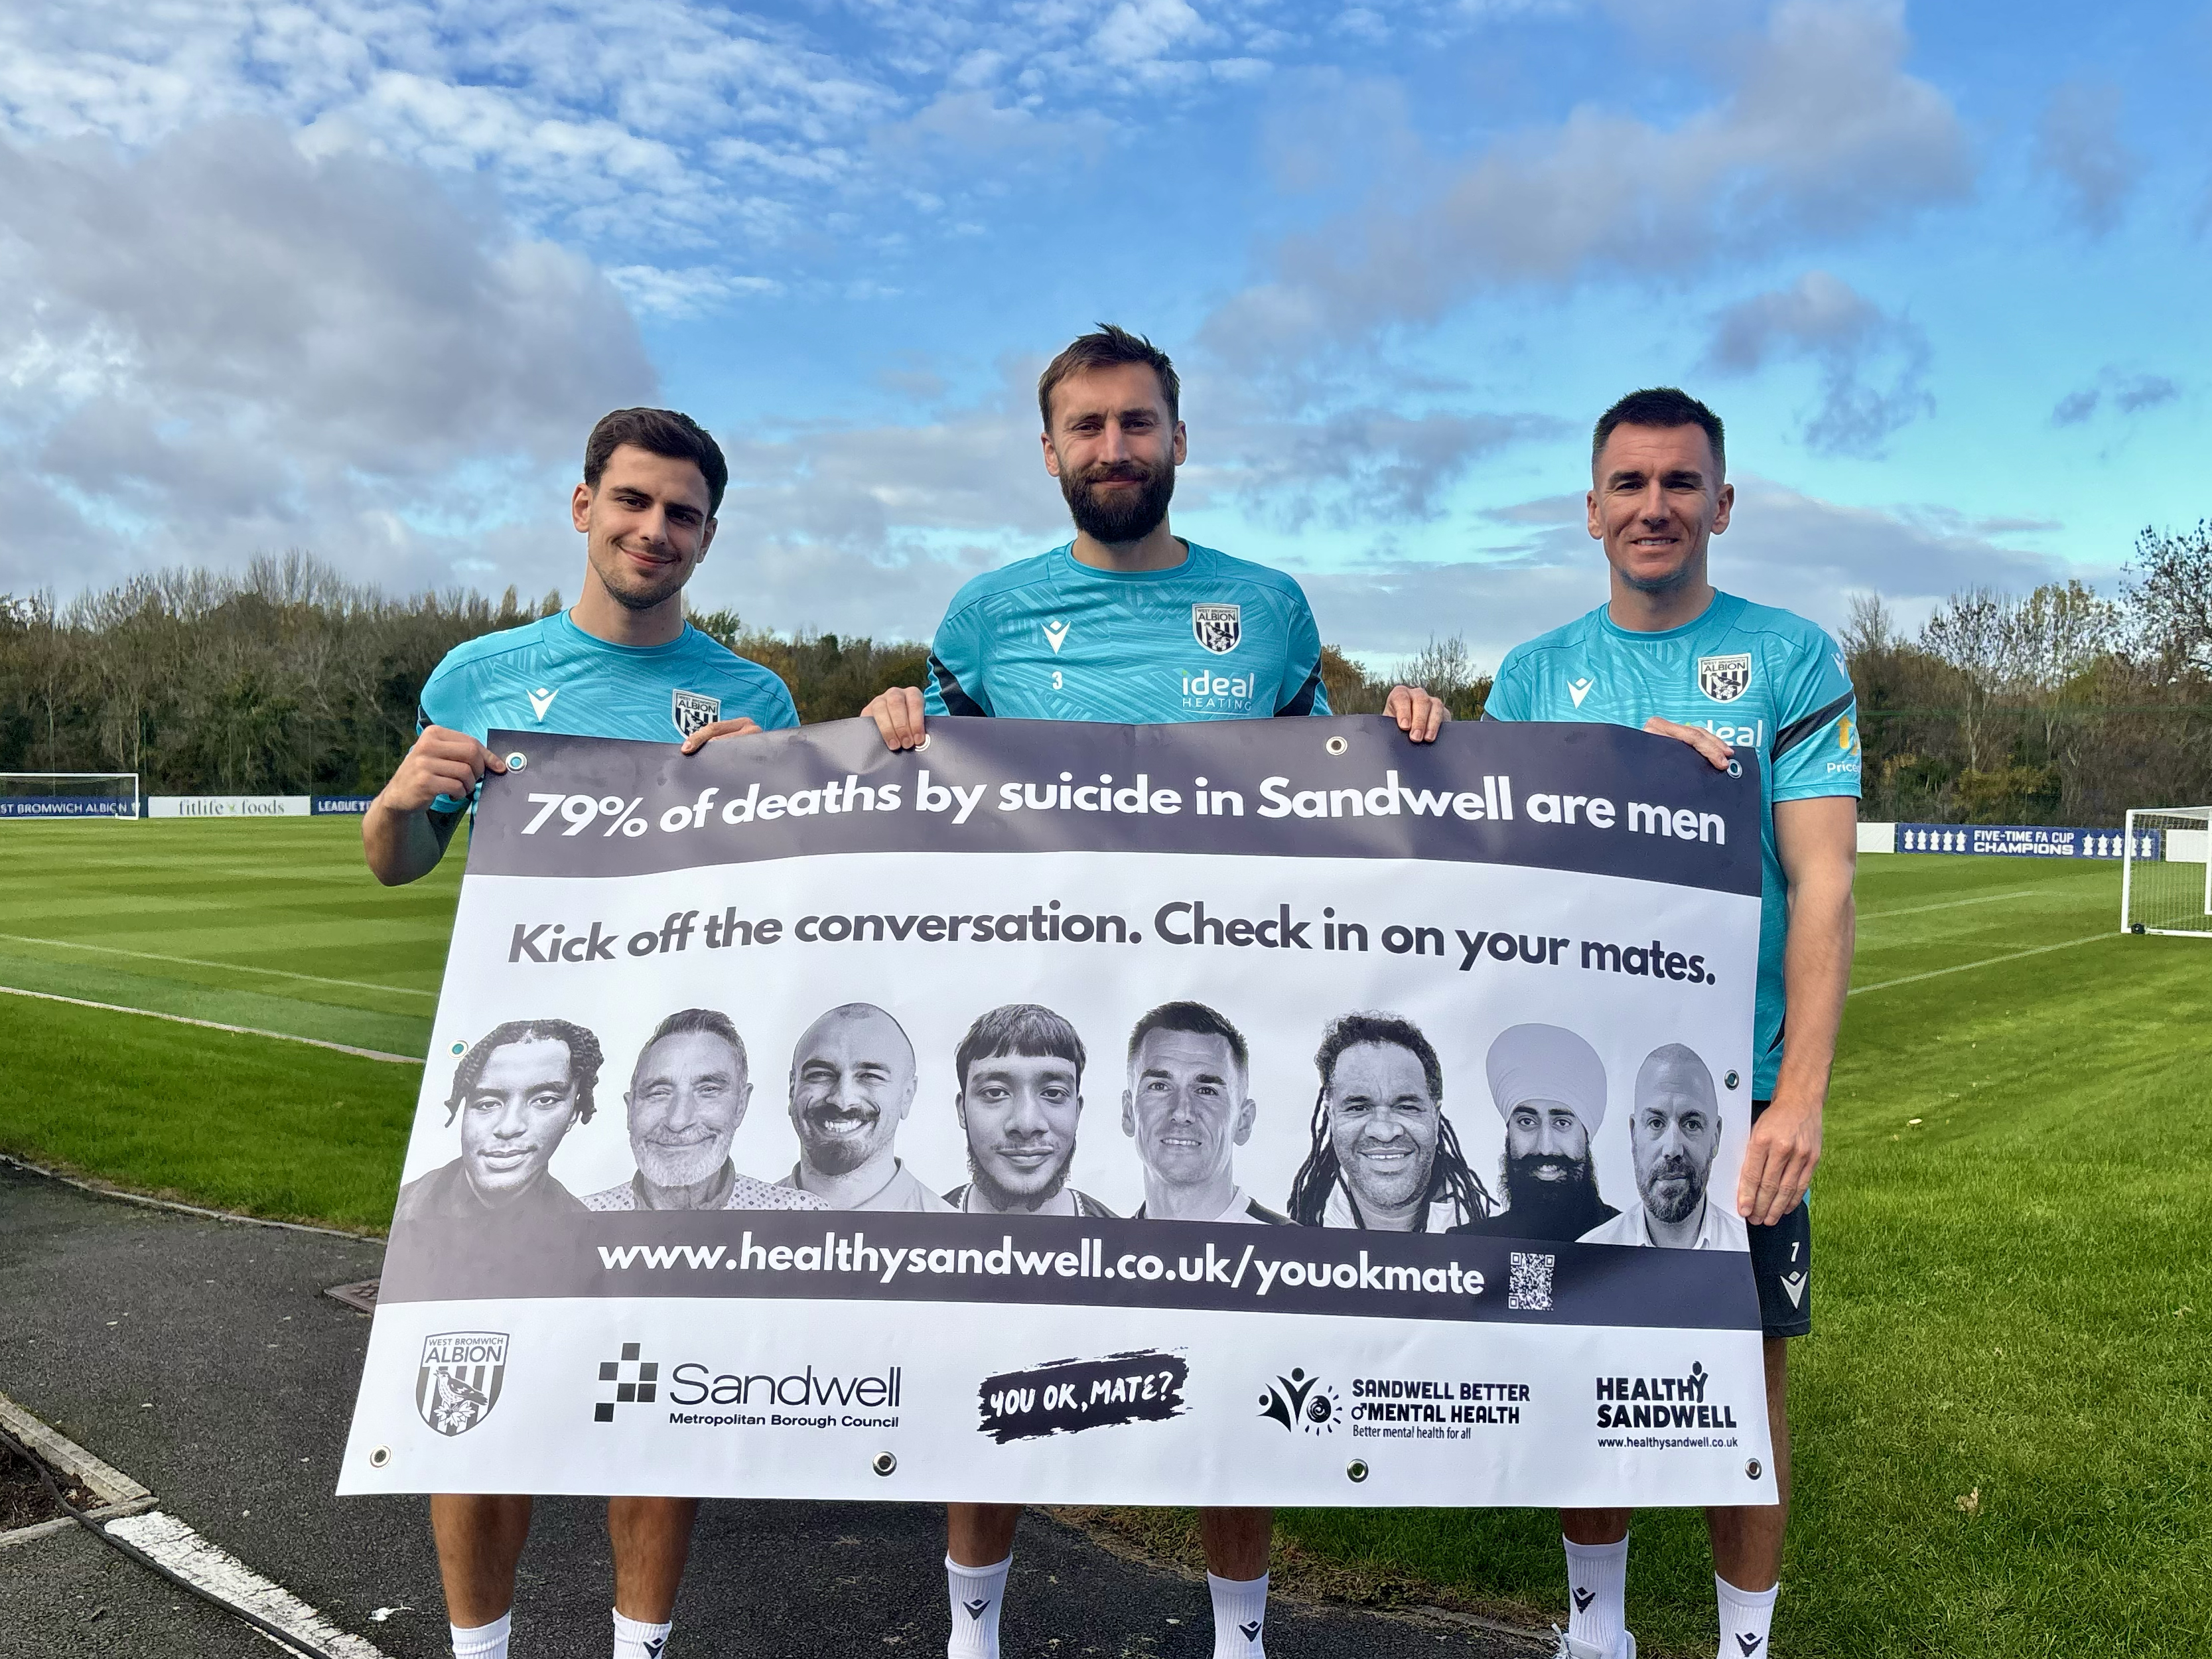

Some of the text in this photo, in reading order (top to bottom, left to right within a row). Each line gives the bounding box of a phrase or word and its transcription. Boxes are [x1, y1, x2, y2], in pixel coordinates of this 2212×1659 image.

[1704, 662, 1746, 672] ALBION
[1052, 671, 1063, 690] 3
[1182, 670, 1255, 699] ideal
[678, 699, 717, 714] ALBION
[1182, 697, 1252, 711] HEATING
[17, 802, 82, 814] BROMWICH
[179, 798, 285, 816] fitlife foods
[521, 770, 1725, 845] 79% of deaths by suicide in Sandwell are men
[1974, 830, 2075, 843] FIVE-TIME FA CUP
[1974, 842, 2074, 855] CHAMPIONS
[508, 899, 1716, 985] Kick off the conversation. Check in on your mates.
[596, 1231, 1485, 1295] www.healthysandwell.co.uk/youokmate
[454, 1337, 504, 1346] BROMWICH
[425, 1346, 502, 1363] ALBION
[669, 1363, 901, 1407] Sandwell
[990, 1387, 1036, 1417] YOU
[1089, 1371, 1174, 1406] MATE?
[1352, 1378, 1531, 1402] SANDWELL BETTER
[1596, 1372, 1708, 1404] HEALTHY
[669, 1413, 899, 1428] Metropolitan Borough Council
[1367, 1402, 1519, 1424] MENTAL HEALTH
[1596, 1404, 1737, 1428] SANDWELL
[1353, 1425, 1471, 1439] Better mental health for all
[1598, 1437, 1738, 1451] www.healthysandwell.co.uk
